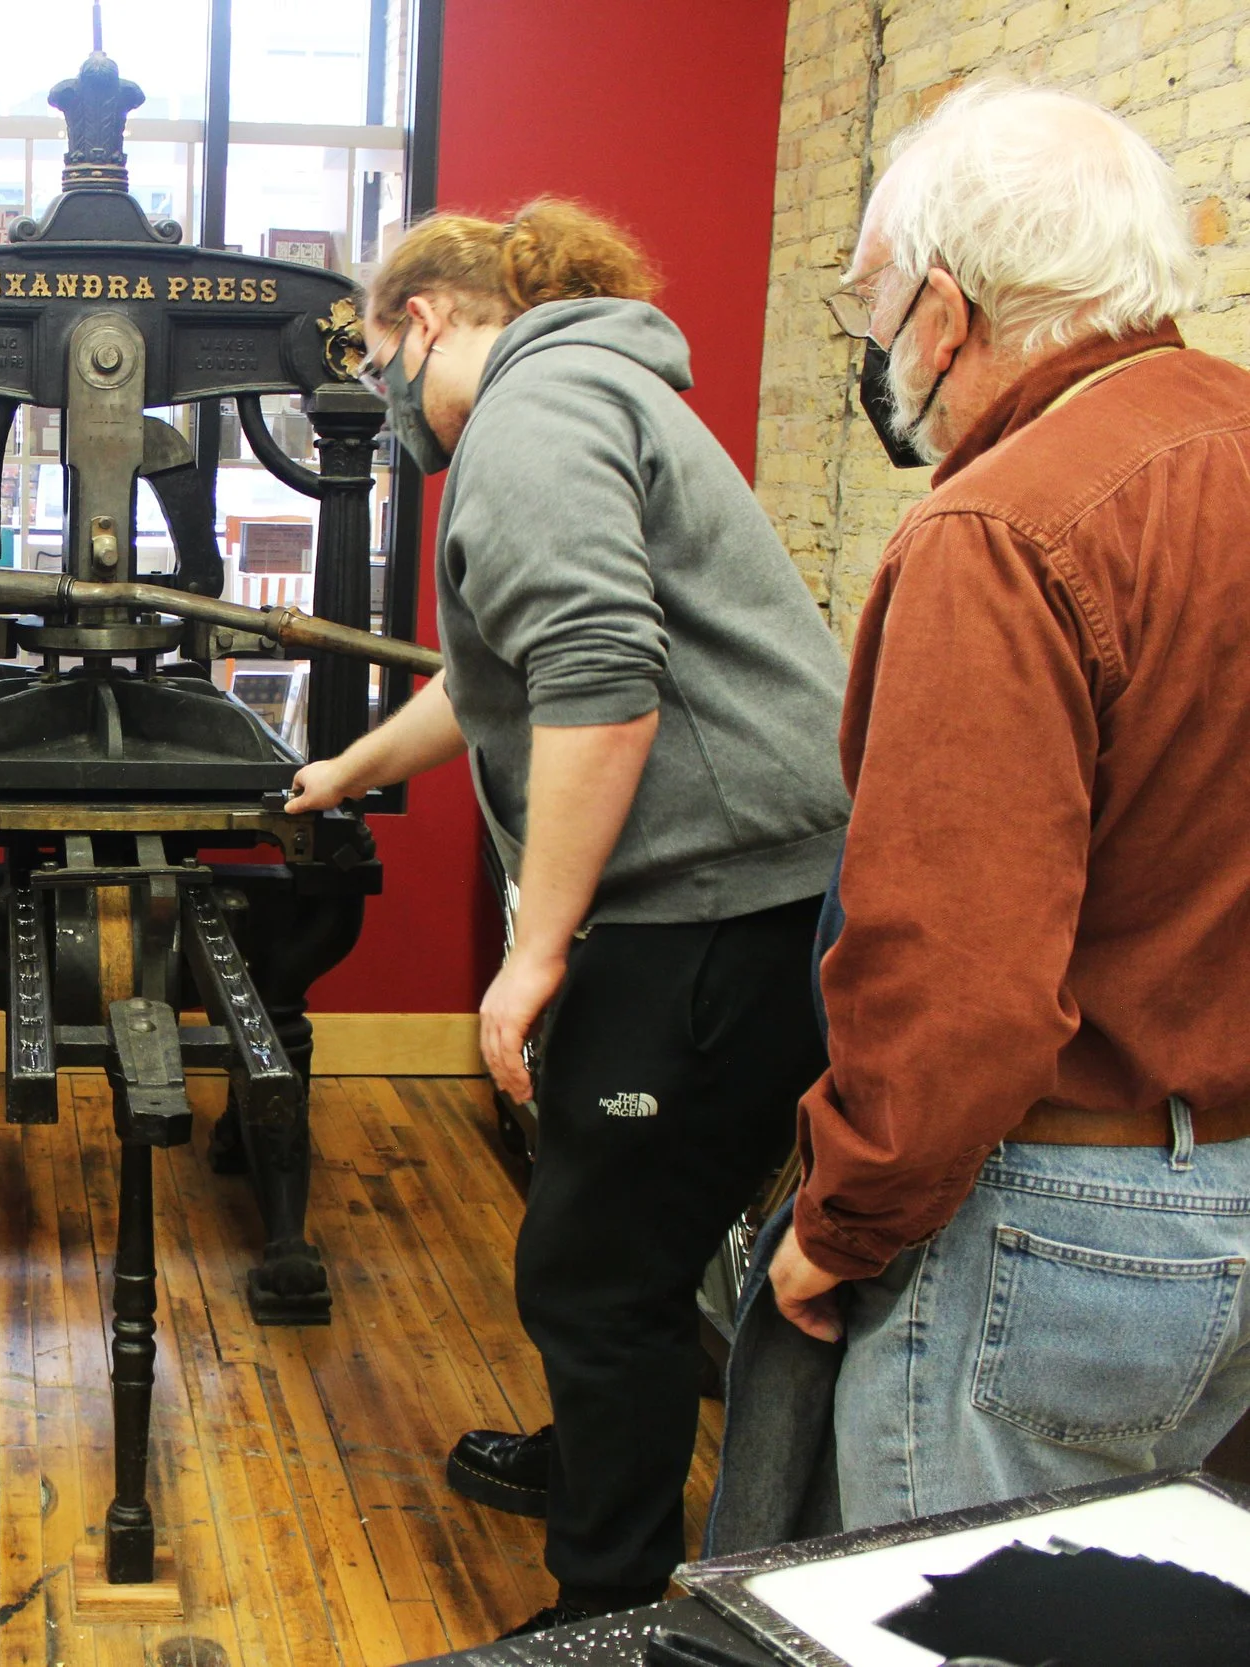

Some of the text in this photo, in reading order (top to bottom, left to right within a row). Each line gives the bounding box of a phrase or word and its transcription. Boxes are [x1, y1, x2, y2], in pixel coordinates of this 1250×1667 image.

[167, 277, 278, 303] PRESS
[195, 356, 259, 371] LONDON
[617, 1092, 639, 1102] THE
[598, 1098, 638, 1110] NORTH
[606, 1107, 636, 1117] FACE
